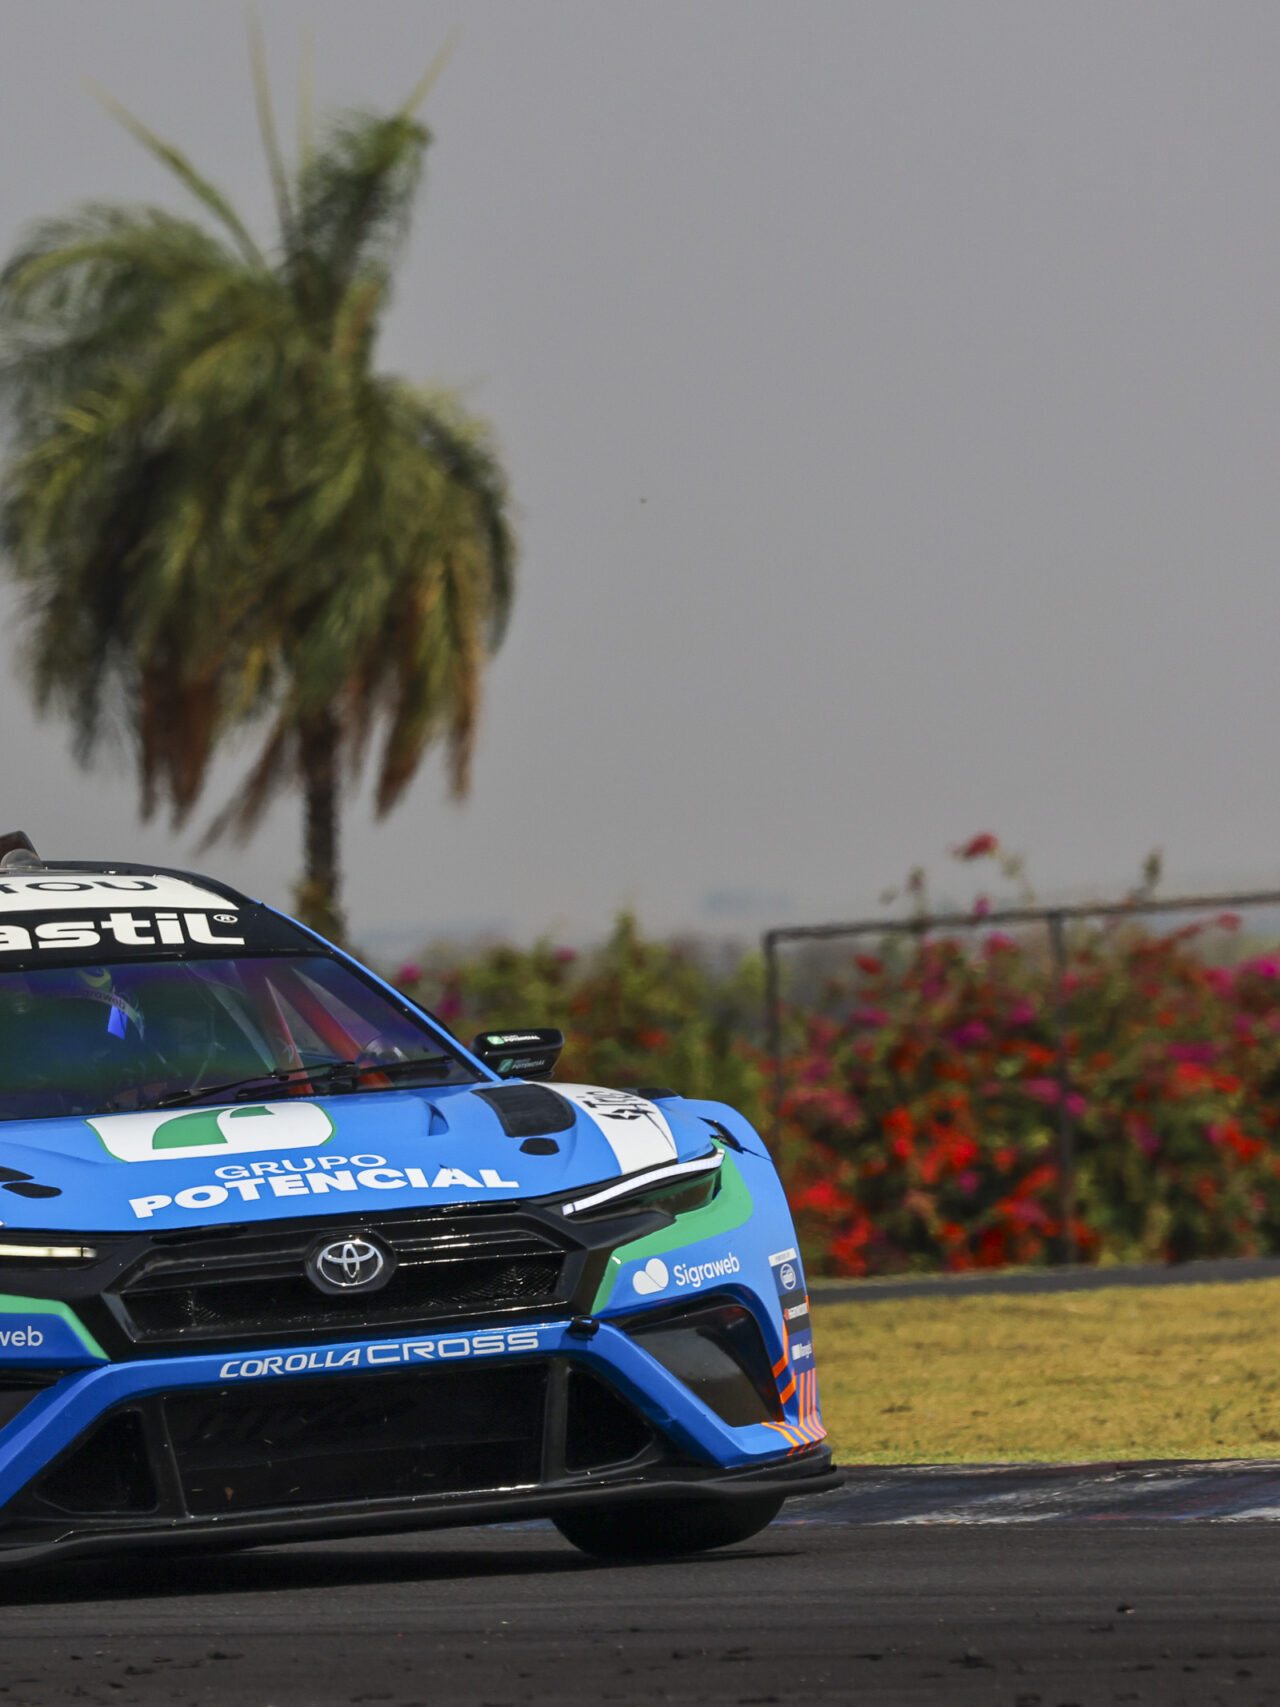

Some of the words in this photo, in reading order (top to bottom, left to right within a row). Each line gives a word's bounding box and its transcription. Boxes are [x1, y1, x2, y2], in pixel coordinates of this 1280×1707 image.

[214, 1155, 387, 1180] GRUPO
[129, 1168, 519, 1219] POTENCIAL
[674, 1253, 740, 1288] Sigraweb
[220, 1349, 360, 1378] COROLLA
[366, 1332, 539, 1364] CROSS
